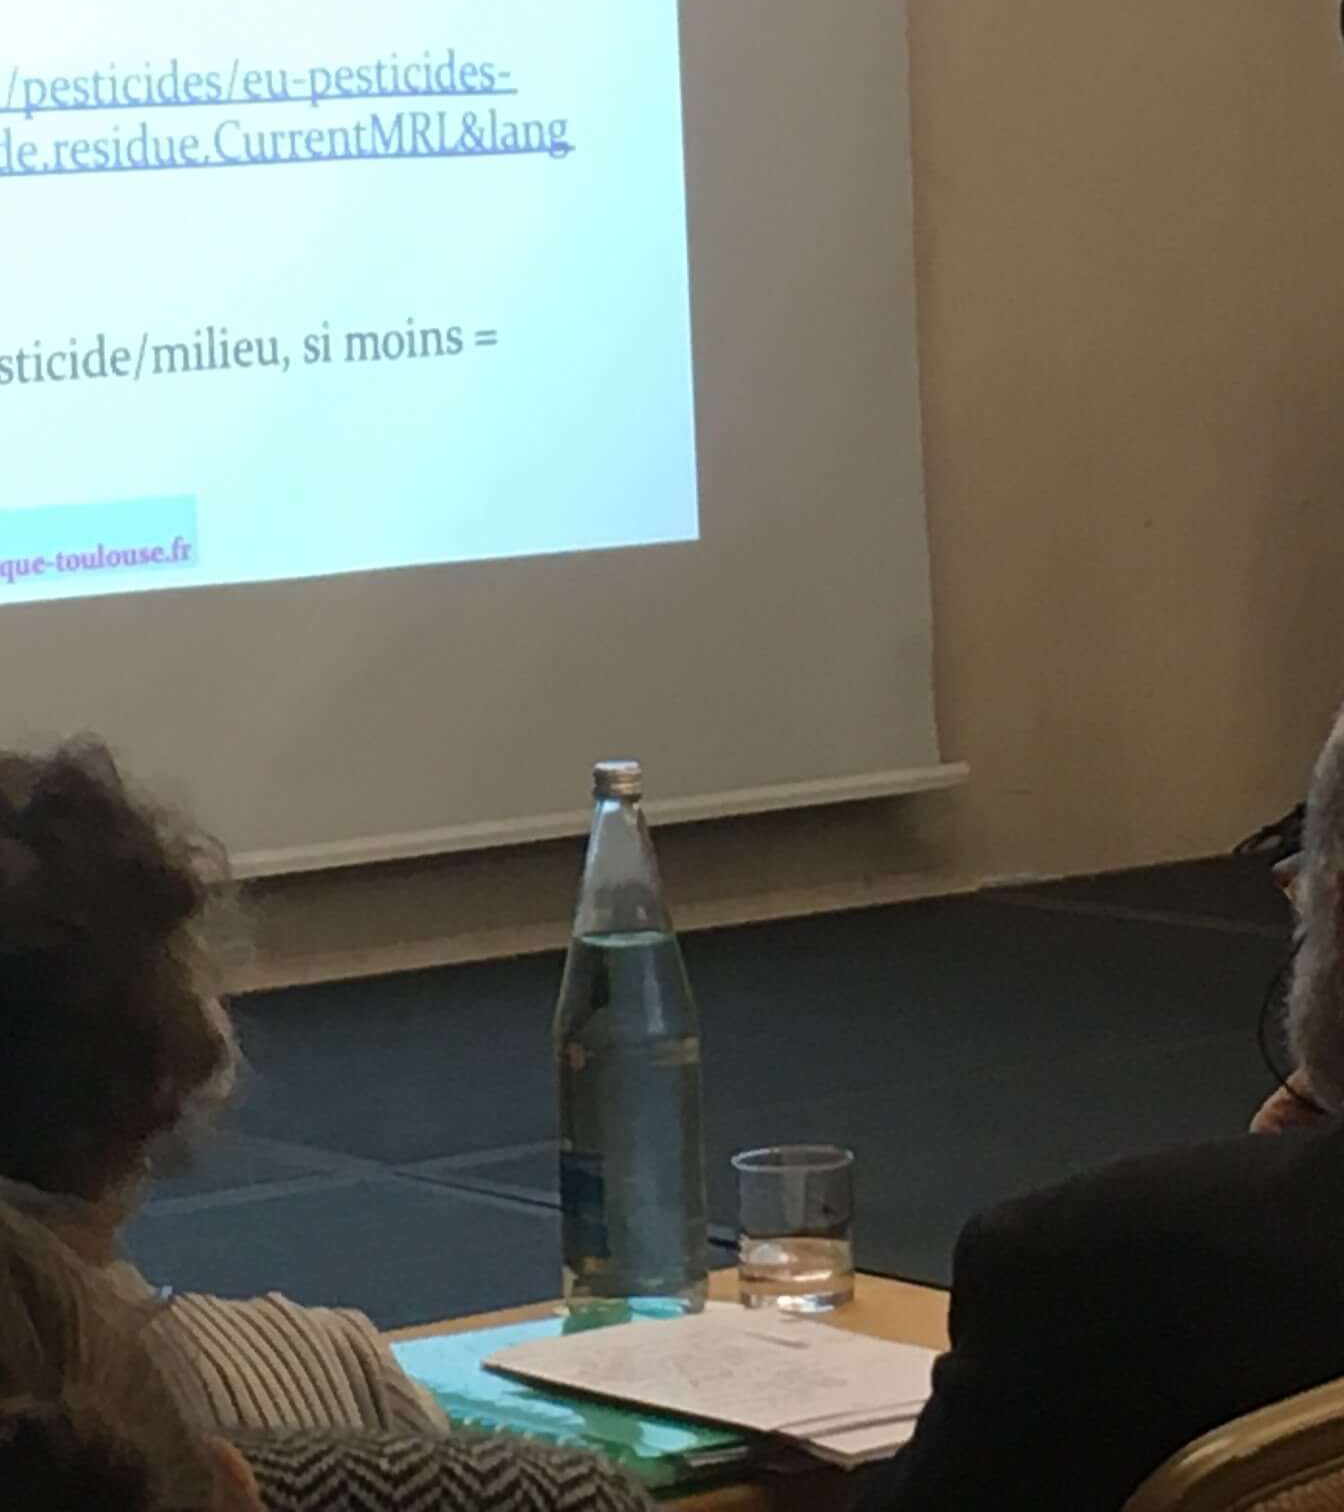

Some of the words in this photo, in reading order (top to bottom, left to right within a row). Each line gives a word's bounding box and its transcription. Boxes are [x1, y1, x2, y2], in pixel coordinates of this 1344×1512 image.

[304, 321, 331, 364] si
[344, 317, 463, 362] moins
[475, 330, 498, 346] =
